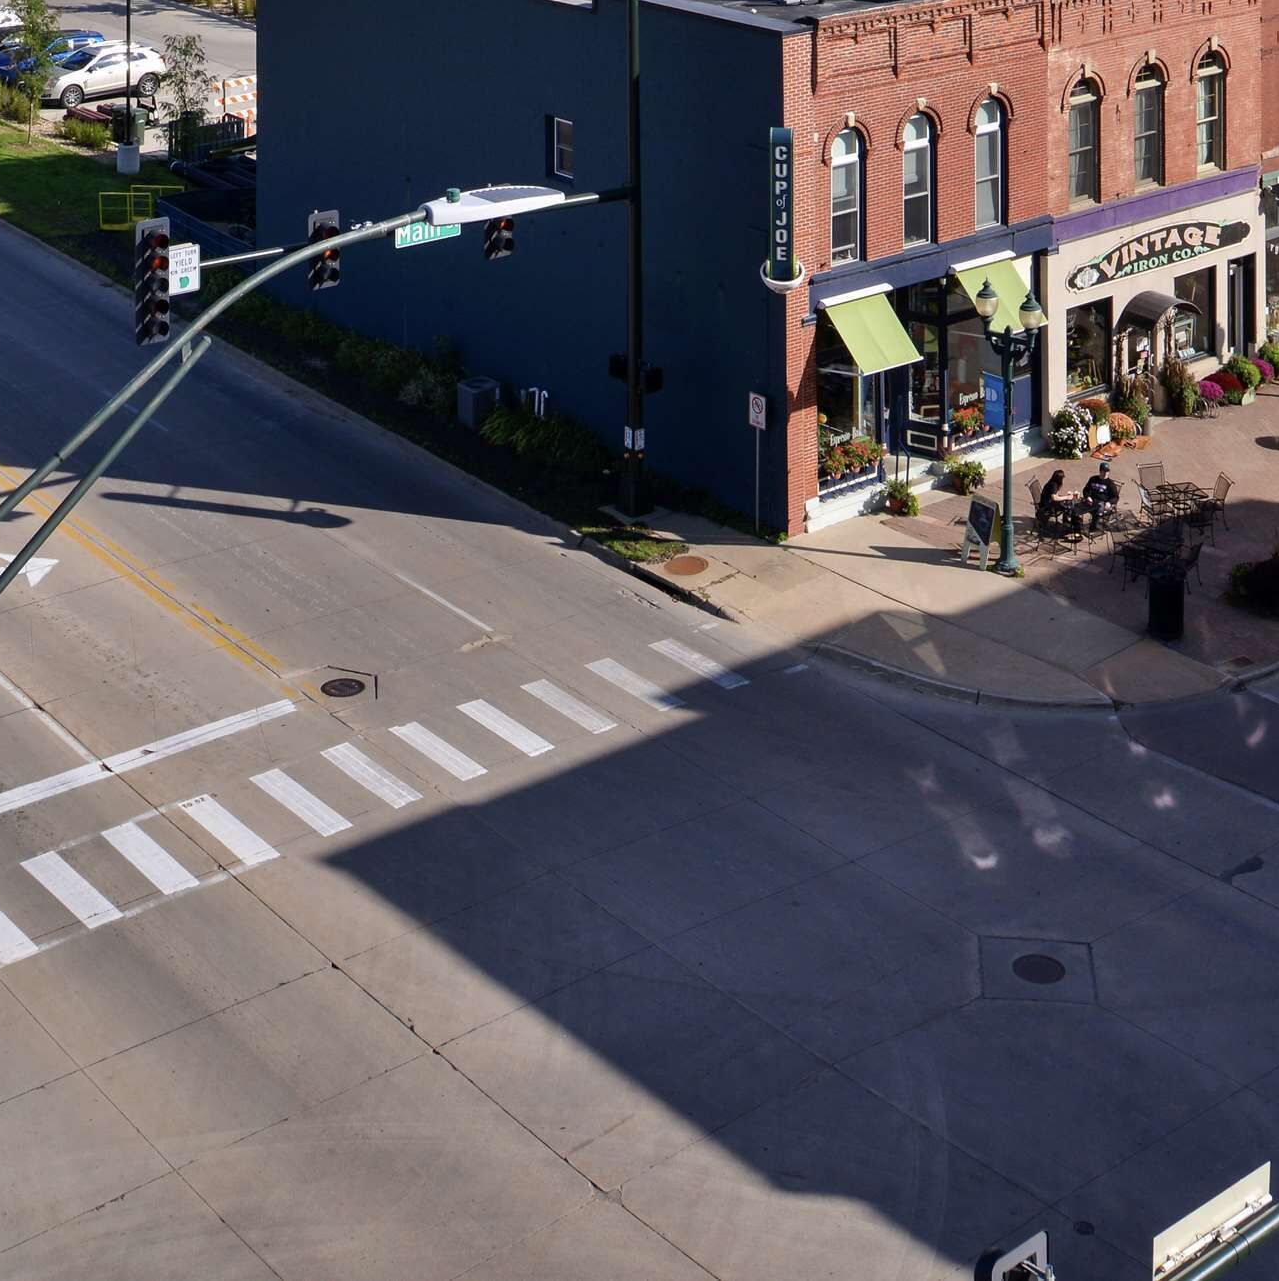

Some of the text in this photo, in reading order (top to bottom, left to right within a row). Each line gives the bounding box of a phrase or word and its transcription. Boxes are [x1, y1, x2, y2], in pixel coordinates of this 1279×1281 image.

[775, 146, 788, 195] CUP
[776, 194, 788, 209] of
[775, 212, 788, 261] JOE
[1099, 225, 1222, 278] VINTAGE
[175, 257, 193, 266] YIELD
[1132, 248, 1195, 274] IRON CO.
